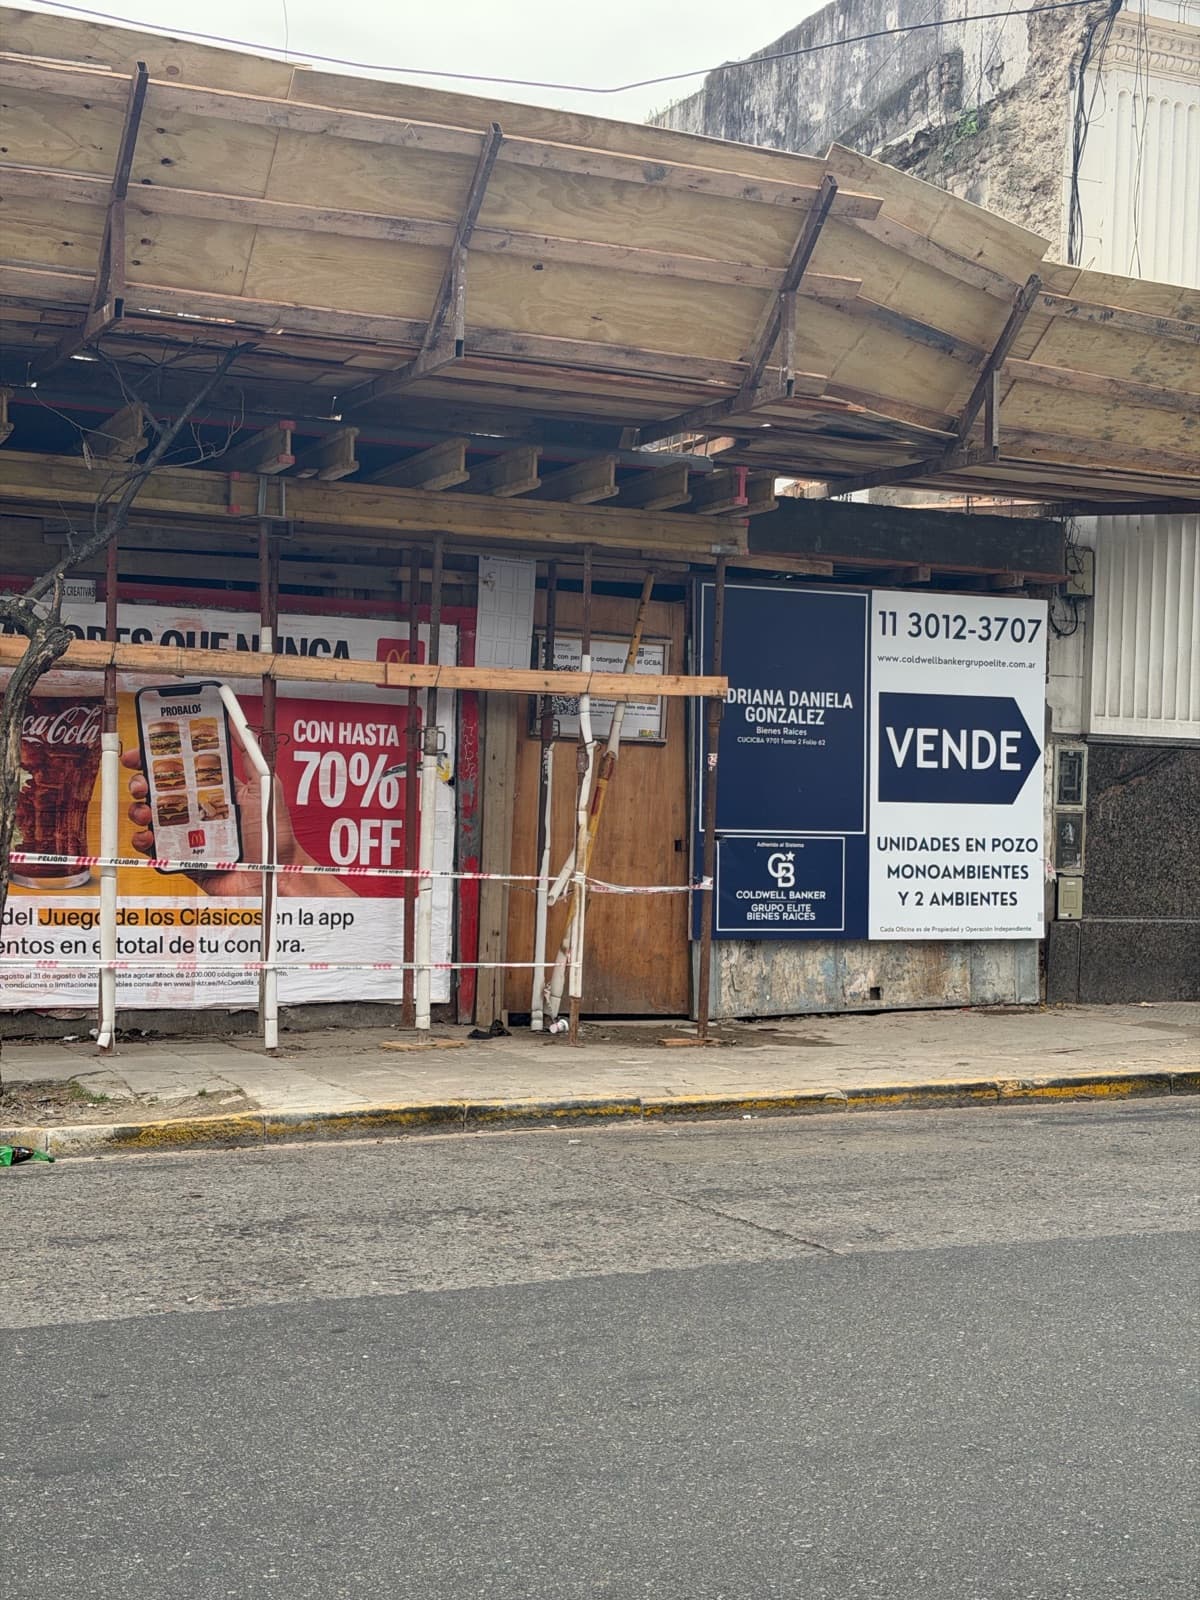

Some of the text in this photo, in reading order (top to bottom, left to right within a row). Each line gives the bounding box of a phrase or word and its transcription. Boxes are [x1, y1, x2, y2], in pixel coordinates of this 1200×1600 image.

[878, 610, 1042, 643] 11 3012-3707
[877, 655, 1036, 669] www.coldwellbankergrupoelite.com.ar
[723, 688, 853, 709] DRIANA DANIELA
[745, 707, 825, 725] GONZALEZ
[293, 719, 400, 747] CON HASTA
[756, 726, 781, 735] Bienes
[885, 726, 1022, 771] VENDE
[293, 751, 400, 809] 70%
[329, 818, 403, 865] OFF
[877, 836, 1039, 853] UNIDADES EN POZO
[887, 864, 1029, 880] MONOAMBIENTES
[736, 890, 826, 899] COLDWELL BANKER
[898, 891, 1018, 906] Y 2 AMBIENTES
[746, 912, 779, 920] BIENES
[751, 904, 811, 912] GRUPO ELITE
[2, 908, 33, 925] del
[145, 908, 174, 925] los
[180, 908, 262, 925] Clásicos
[299, 908, 313, 925] la
[319, 912, 354, 929] app
[60, 942, 86, 954] en
[117, 936, 163, 953] total
[169, 936, 195, 953] de
[200, 937, 218, 953] tu
